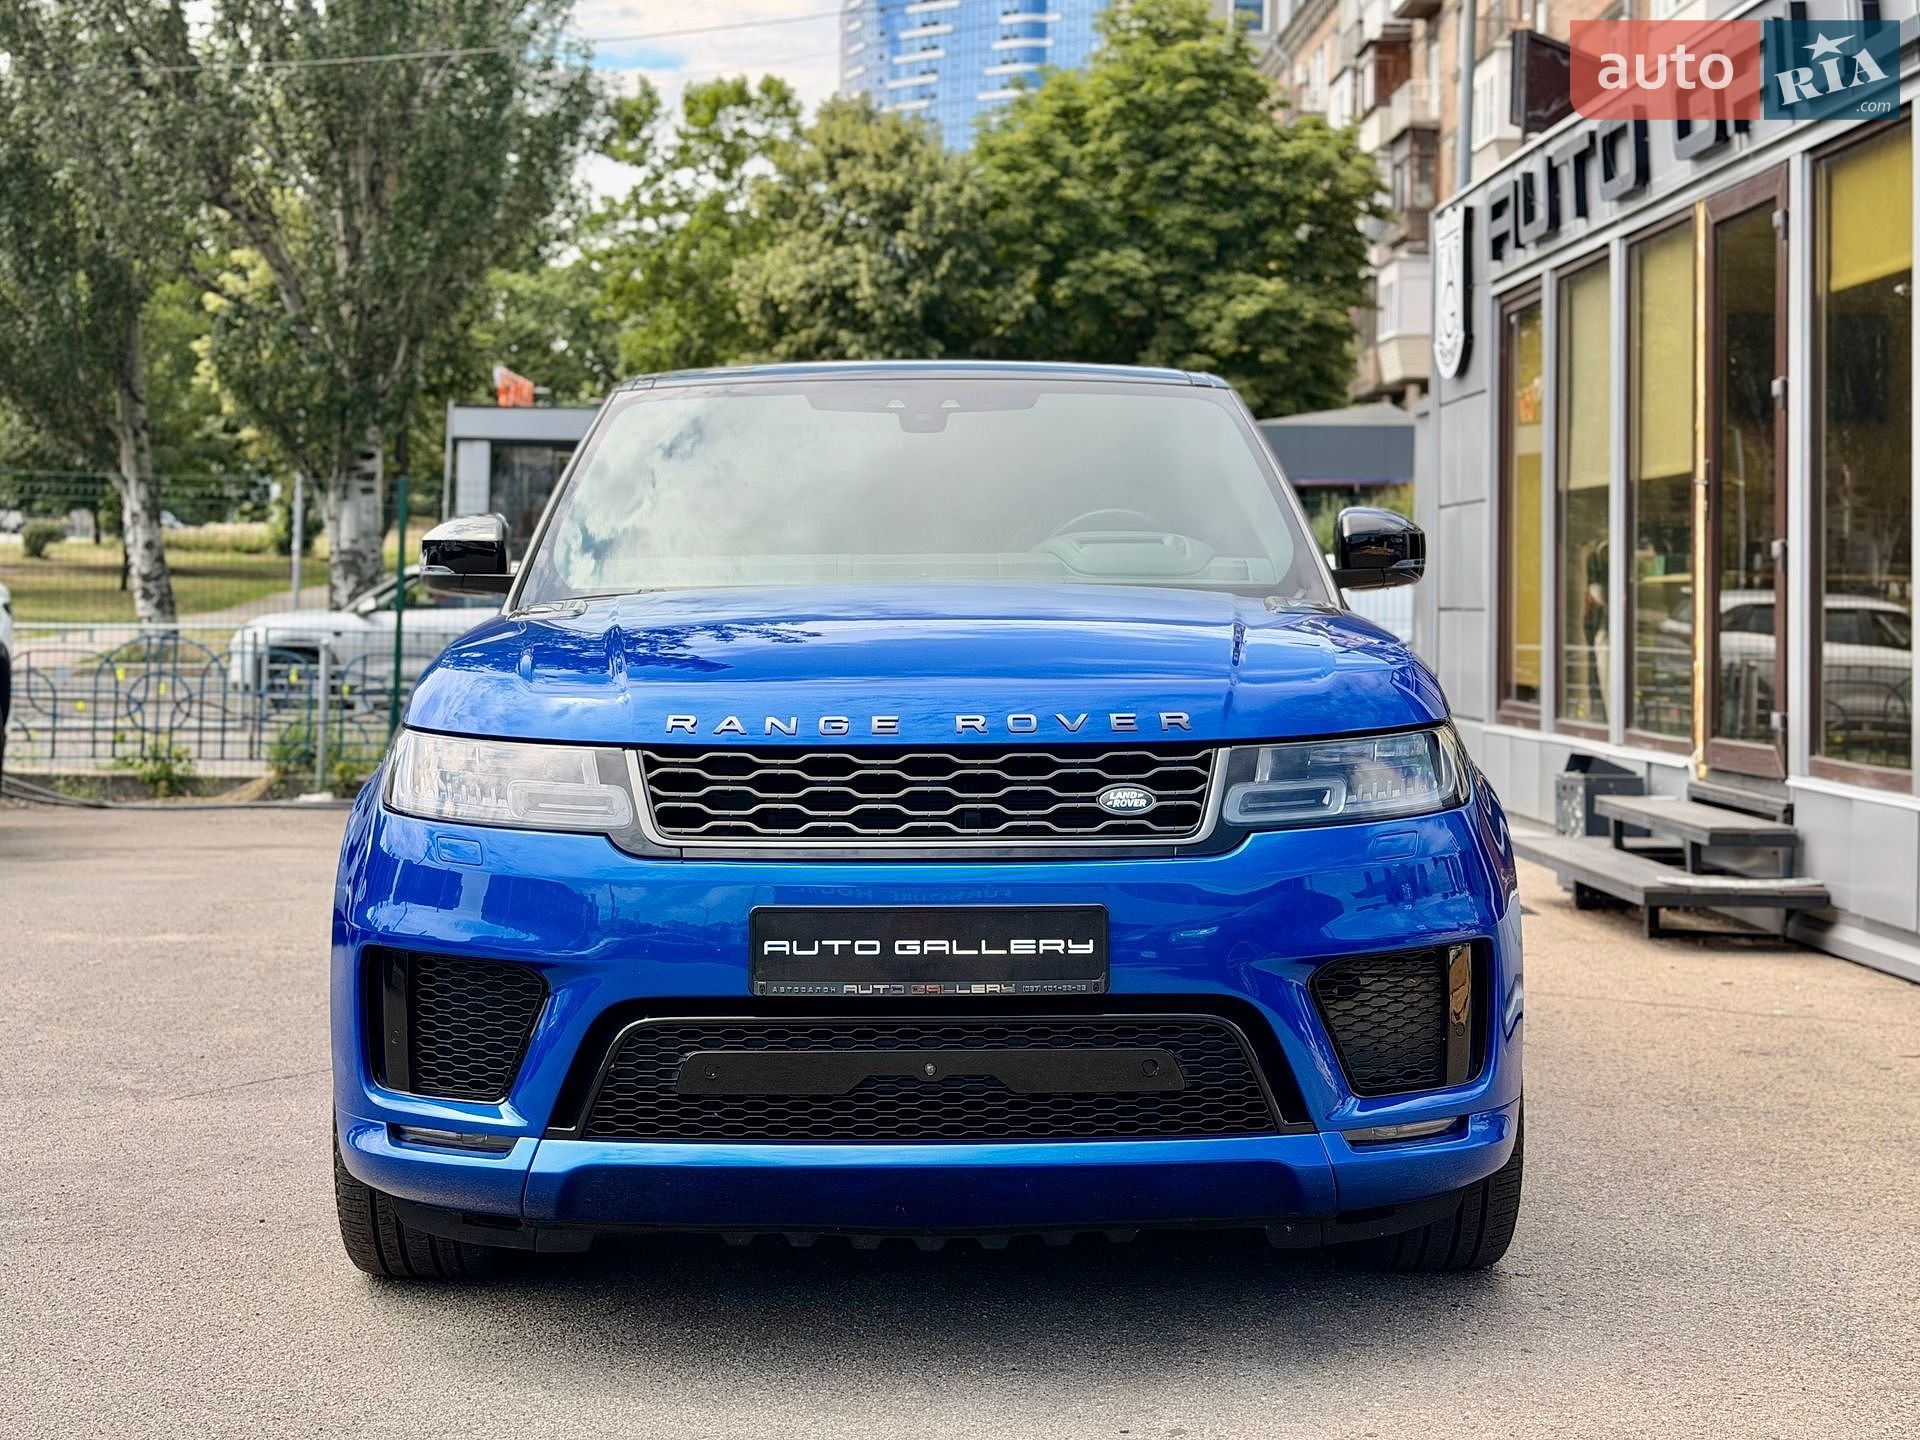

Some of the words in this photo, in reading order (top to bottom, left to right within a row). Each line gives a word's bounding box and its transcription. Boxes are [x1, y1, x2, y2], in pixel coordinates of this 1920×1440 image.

[1487, 103, 1648, 262] AUTO
[664, 713, 900, 736] RANGE
[955, 711, 1194, 733] ROVER
[1110, 791, 1138, 800] LAND
[1112, 798, 1147, 808] ROVER
[763, 939, 881, 956] AUTO
[894, 938, 1094, 955] GALLERY
[843, 984, 905, 994] AUTO
[911, 983, 1016, 994] GALLERY
